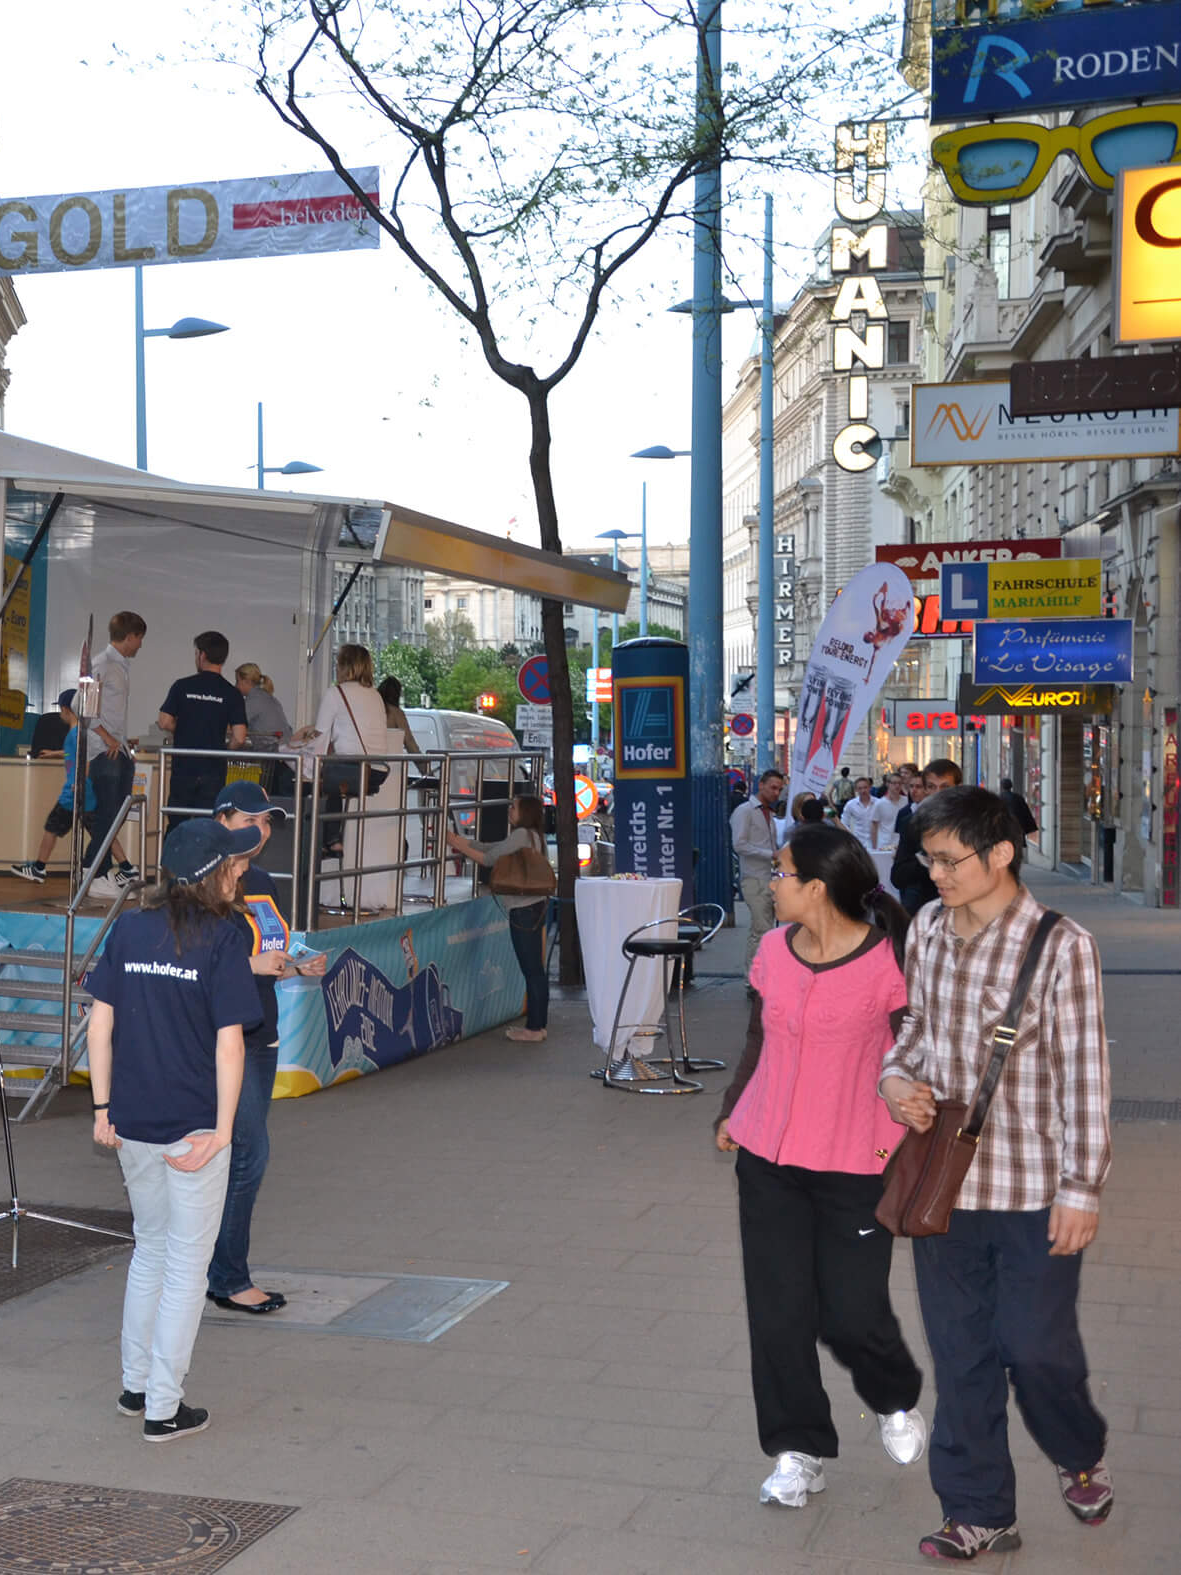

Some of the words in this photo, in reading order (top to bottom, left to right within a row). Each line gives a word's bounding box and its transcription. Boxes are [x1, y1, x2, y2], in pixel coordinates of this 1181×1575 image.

[829, 121, 890, 472] HUMANIC
[992, 576, 1098, 591] FAHRSCHULE
[775, 535, 795, 665] HIRMER
[993, 595, 1084, 609] MARIAHILF
[999, 627, 1107, 651] Parfümerie
[906, 711, 958, 730] ara
[624, 743, 672, 762] Hofer
[656, 785, 673, 796] 1
[657, 802, 675, 829] Nr.
[262, 937, 284, 952] Hofer
[124, 960, 198, 981] www.hofer.at
